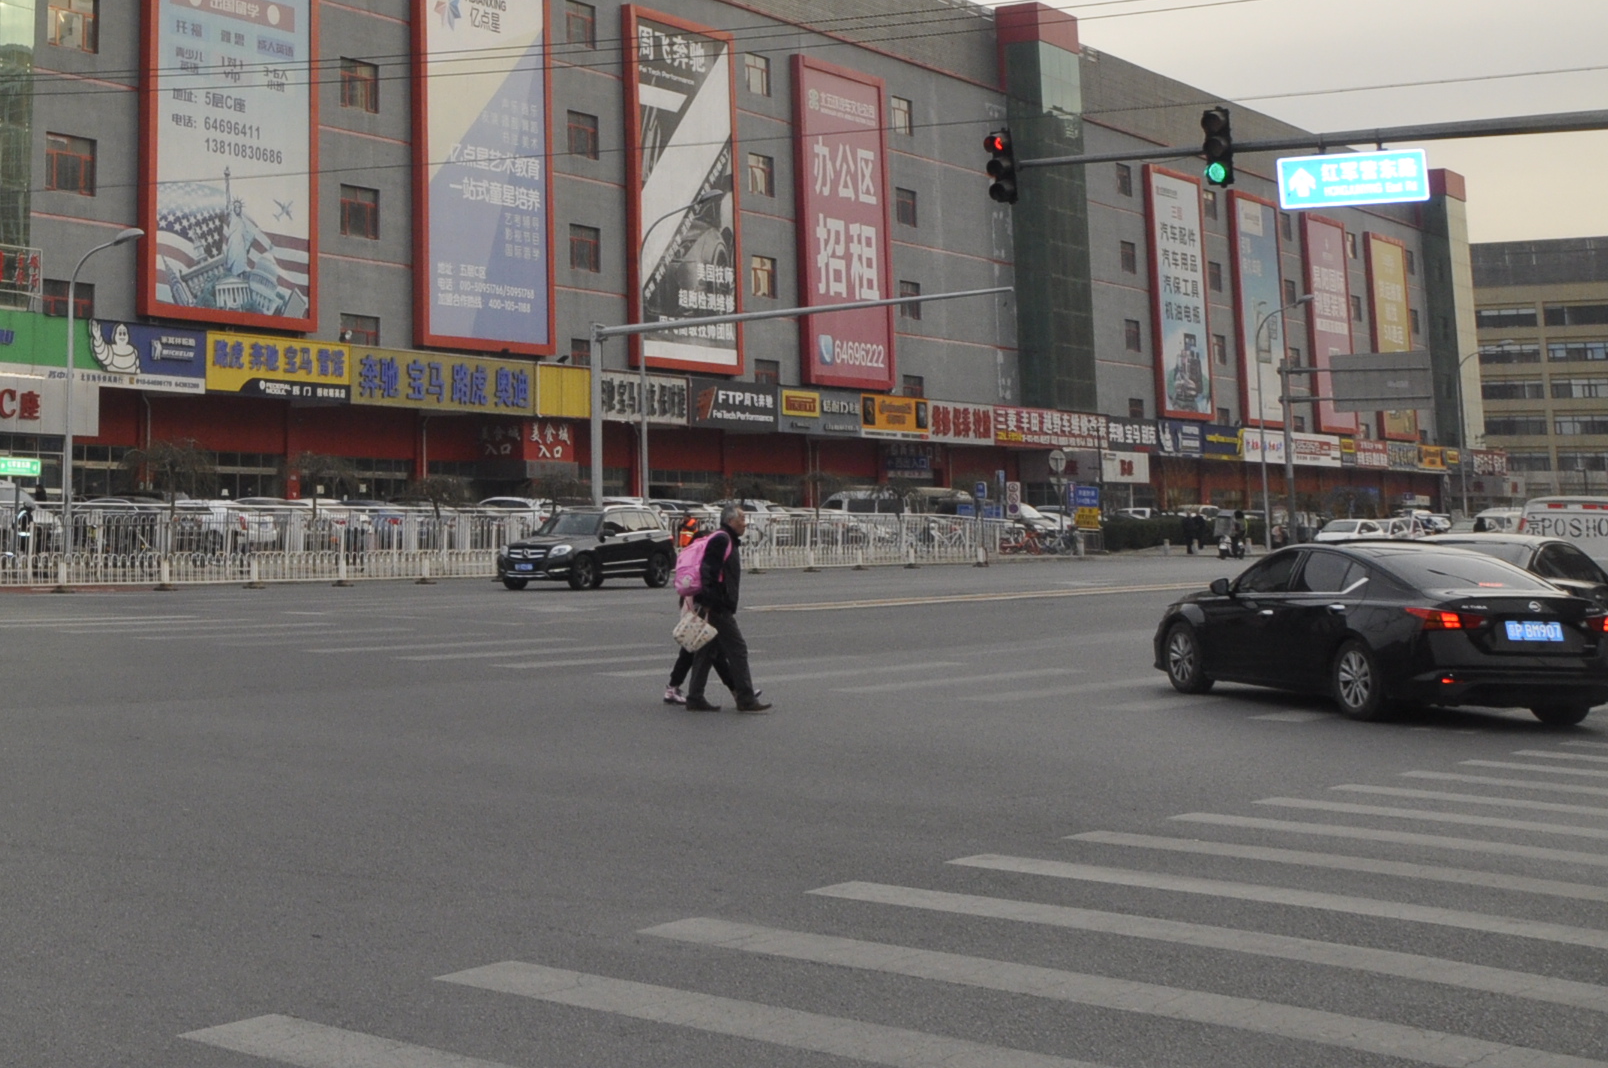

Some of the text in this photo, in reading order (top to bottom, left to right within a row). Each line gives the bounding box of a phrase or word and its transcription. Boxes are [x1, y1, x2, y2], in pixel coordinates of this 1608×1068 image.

[176, 19, 202, 38] 托福
[469, 6, 502, 34] 亿点星
[175, 46, 203, 62] 青少儿
[205, 91, 246, 113] 5层C座
[204, 116, 260, 140] 64696411
[205, 137, 283, 165] 13810830686
[450, 143, 540, 181] 亿点星艺术教育
[813, 135, 878, 206] 办公区
[1321, 157, 1418, 182] 红军营东路
[449, 177, 541, 212] 一站式童星培养
[1405, 181, 1418, 192] Rd
[1160, 222, 1196, 248] 汽车配件
[816, 213, 880, 300] 招租
[1162, 248, 1198, 274] 汽车用品
[1163, 274, 1200, 299] 汽保工具
[162, 348, 194, 358] MICHELIN
[212, 339, 245, 369] 路虎
[249, 341, 280, 372] 奔驰
[283, 345, 313, 375] 宝马
[834, 339, 885, 368] 64696222
[358, 354, 529, 409] 奔驰 宝马 路虎 奥迪
[530, 422, 571, 446] 美食城
[996, 410, 1017, 432] 三菱
[1020, 411, 1040, 433] 丰田
[538, 443, 564, 459] 入口
